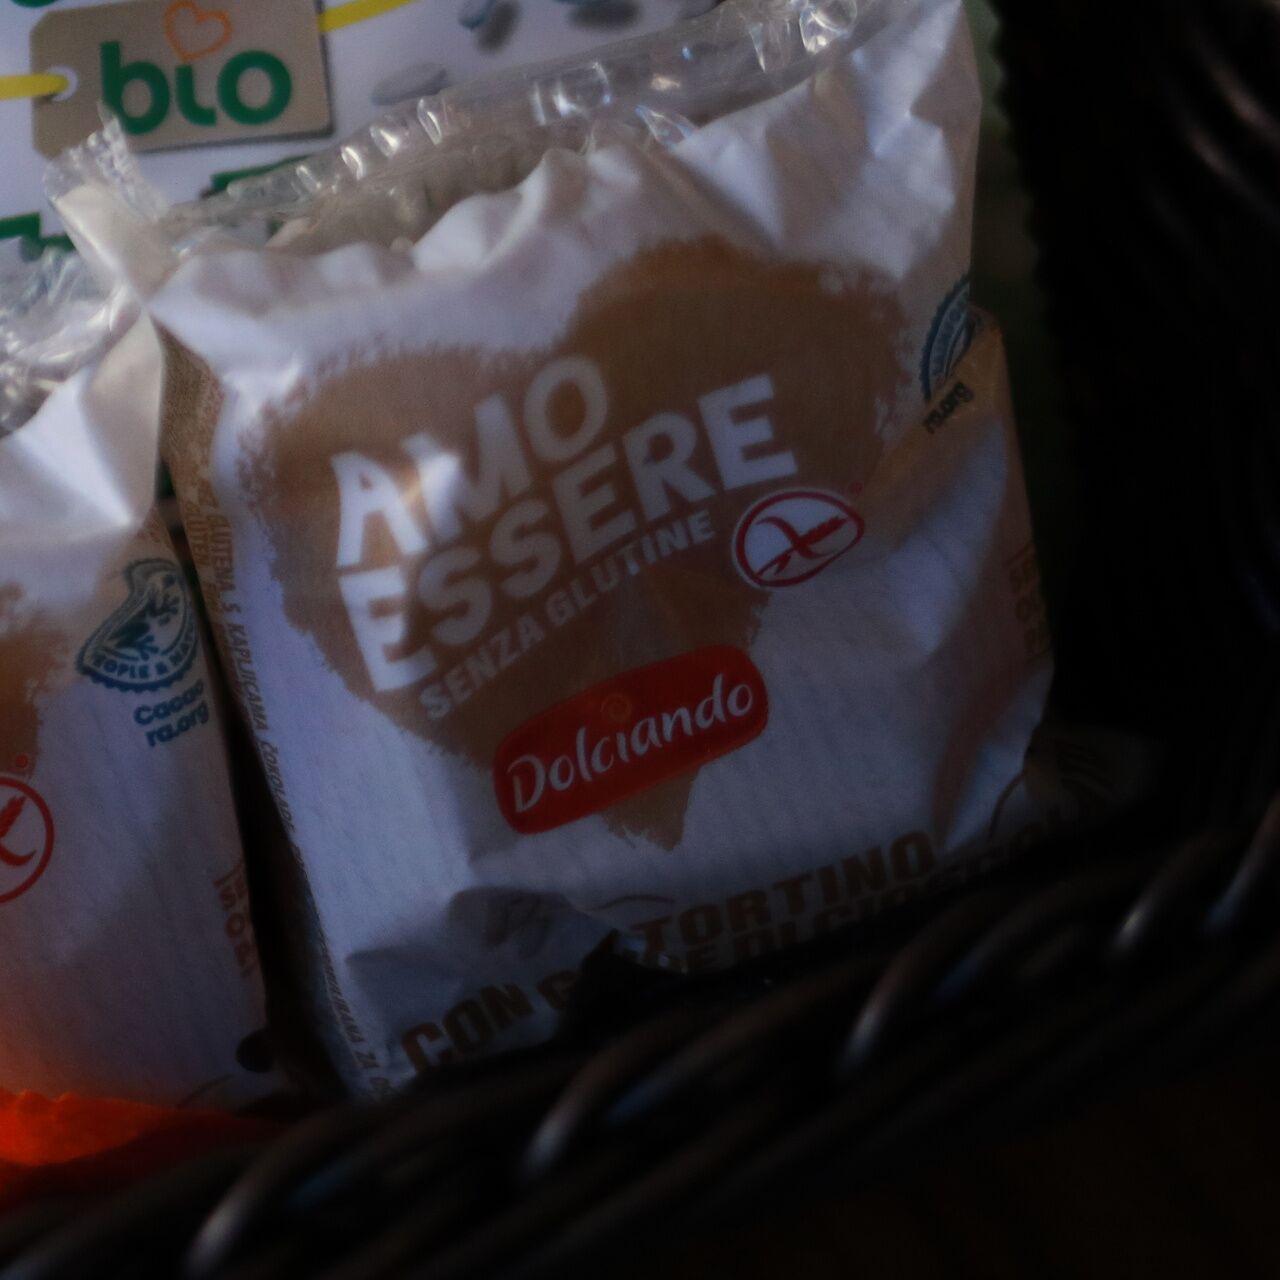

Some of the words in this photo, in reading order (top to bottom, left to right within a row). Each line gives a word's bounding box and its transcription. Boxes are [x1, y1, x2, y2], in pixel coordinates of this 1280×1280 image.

[98, 36, 293, 137] bio
[330, 355, 609, 568] AMO
[338, 372, 799, 693] ESSERE
[419, 620, 546, 721] SENZA
[544, 508, 717, 628] GLUTINE
[506, 672, 755, 814] Dolciando
[638, 829, 939, 956] TORTINO
[399, 978, 534, 1076] CON
